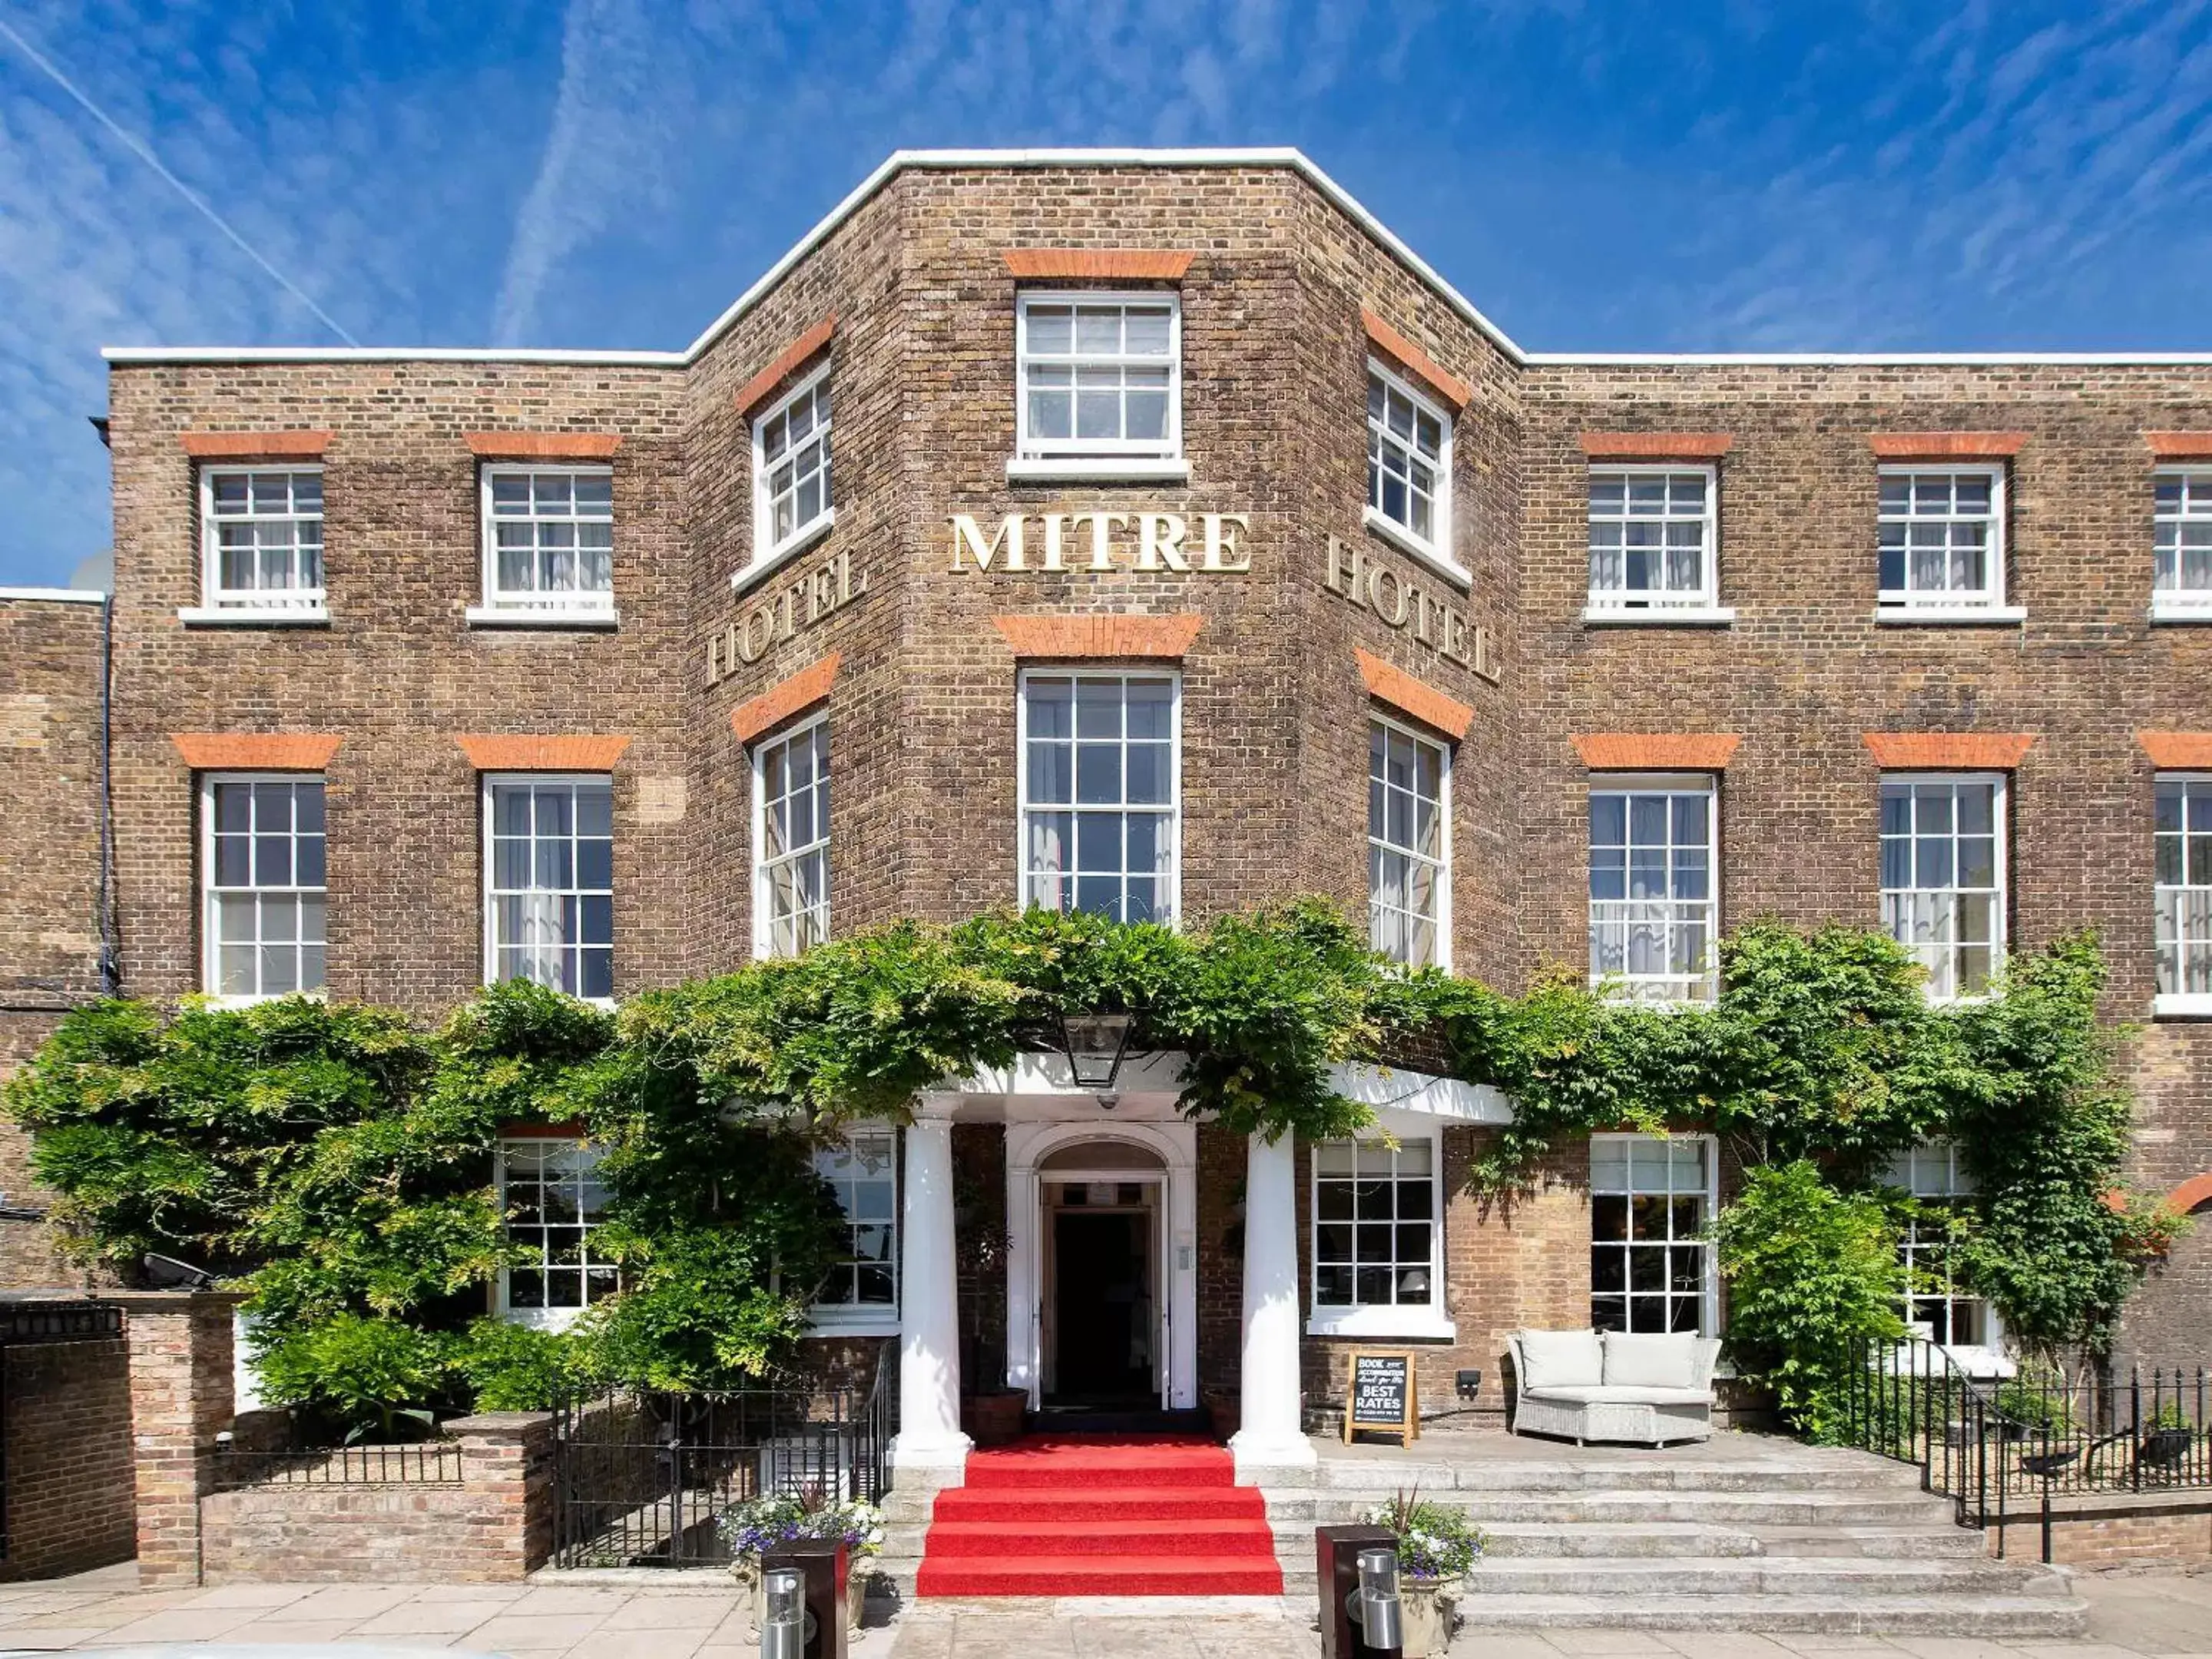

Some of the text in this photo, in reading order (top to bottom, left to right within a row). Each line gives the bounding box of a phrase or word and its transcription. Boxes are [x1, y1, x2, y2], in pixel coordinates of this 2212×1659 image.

[948, 513, 1251, 574] MITRE
[705, 548, 868, 687] HOTEL
[1323, 532, 1502, 684] HOTEL
[1358, 1358, 1384, 1368] BOOK
[1356, 1397, 1401, 1409] RATES
[1363, 1385, 1396, 1397] BEST
